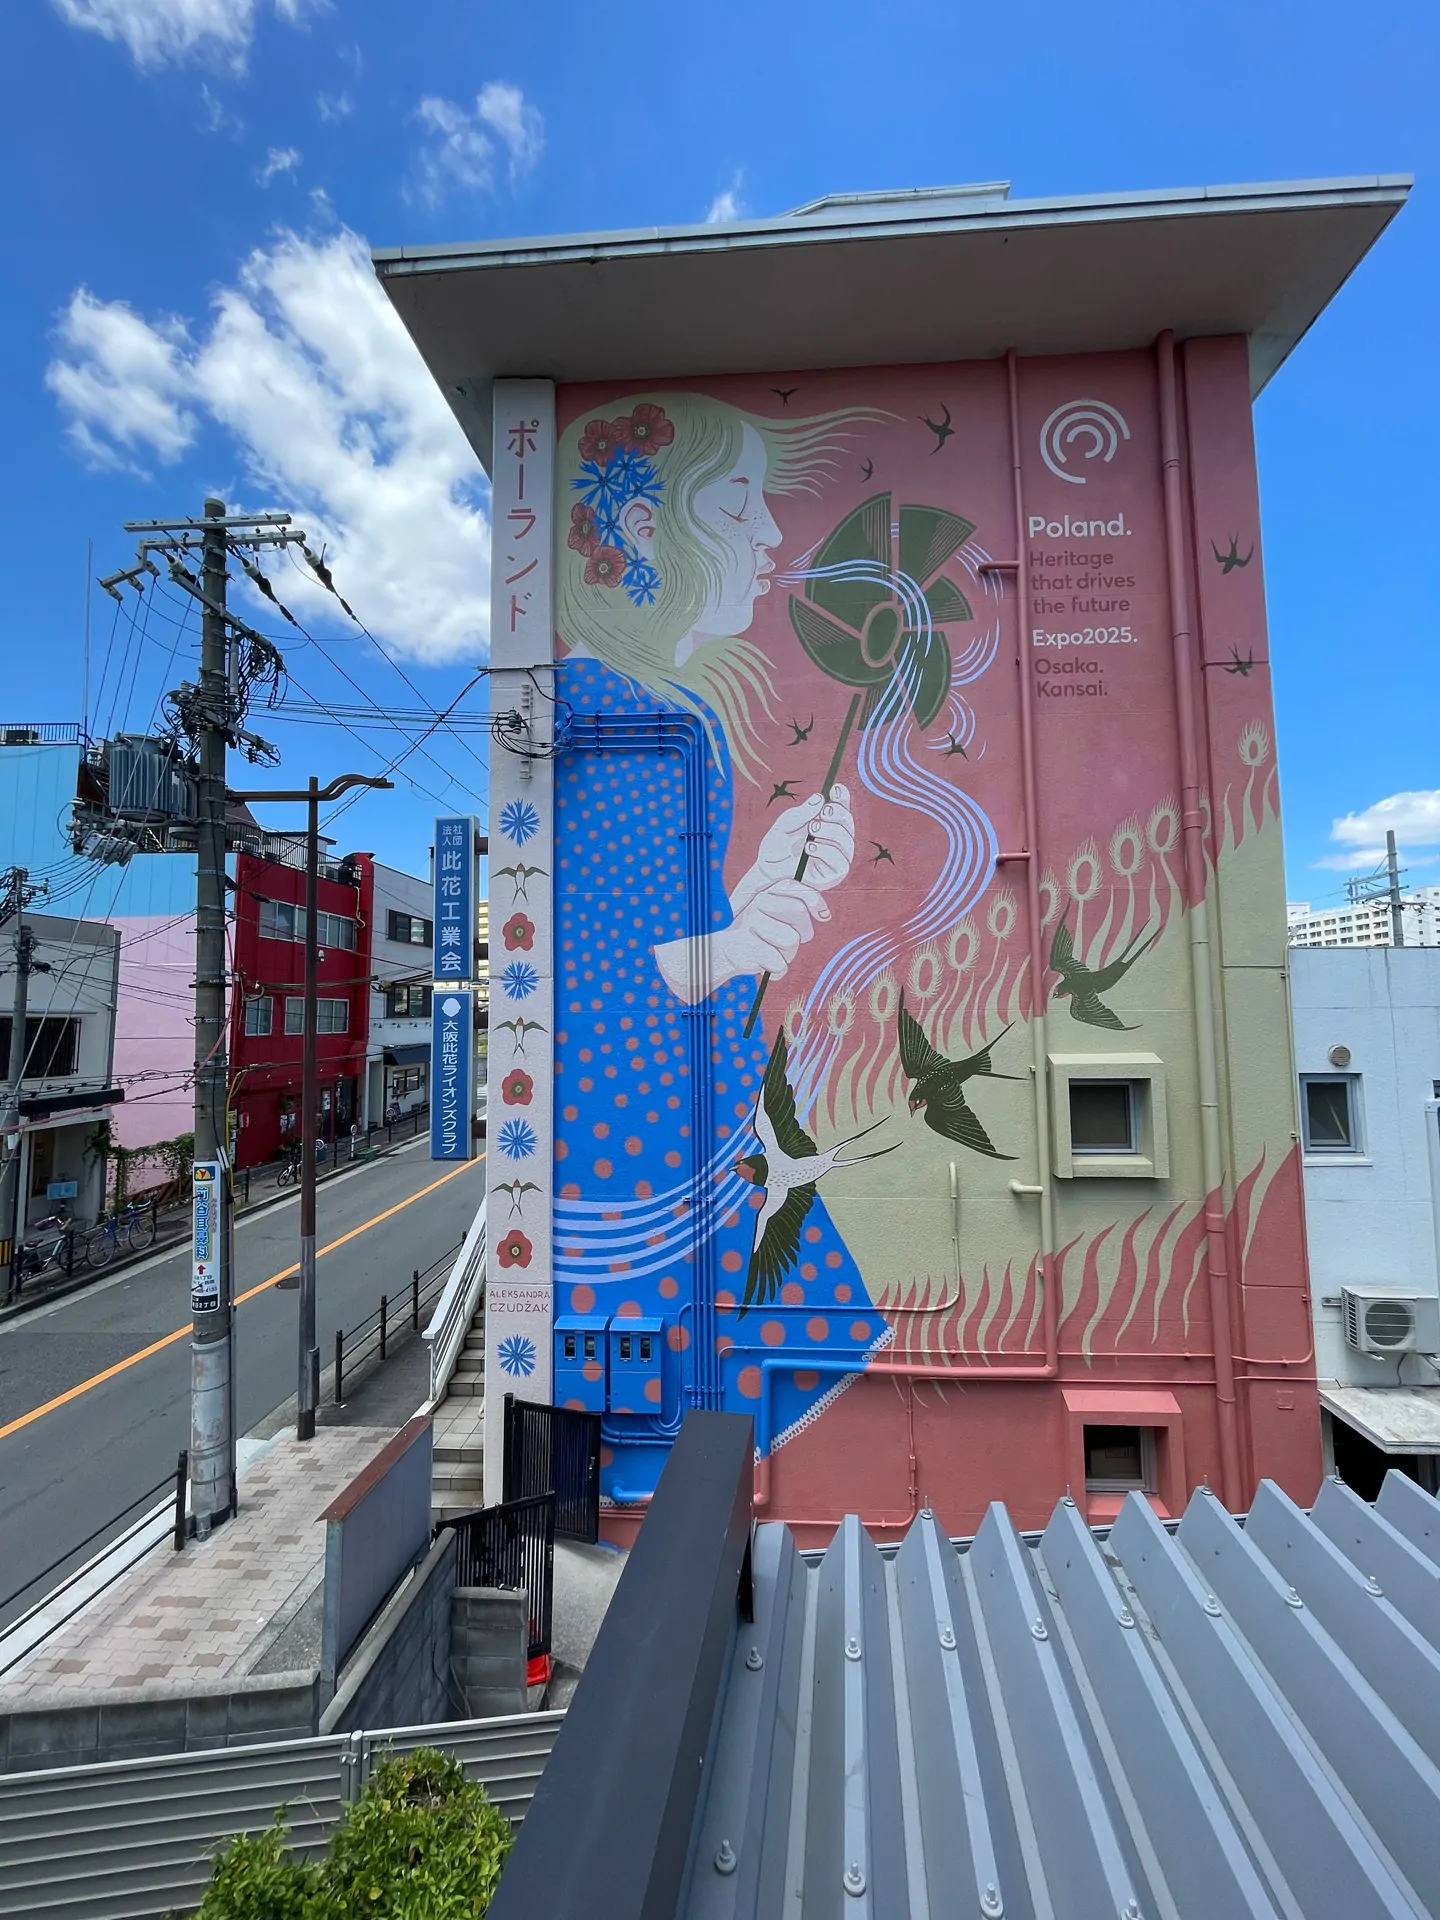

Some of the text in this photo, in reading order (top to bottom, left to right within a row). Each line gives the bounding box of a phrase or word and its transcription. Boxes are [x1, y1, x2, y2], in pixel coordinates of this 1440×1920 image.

[505, 420, 540, 632] ポーランド
[1028, 513, 1132, 538] Poland.
[1030, 551, 1114, 569] Heritage
[1031, 572, 1136, 591] that drives
[1033, 596, 1130, 614] the future
[1032, 627, 1138, 649] Expo2025.
[1034, 657, 1104, 675] Osaka.
[1037, 680, 1108, 698] Kansai.
[440, 850, 462, 972] 此花工業会
[442, 1020, 459, 1154] 大阪此花ライオンズクラブ
[489, 1290, 551, 1299] ALEKSANDRA
[489, 1301, 549, 1313] CZUDŻAK
